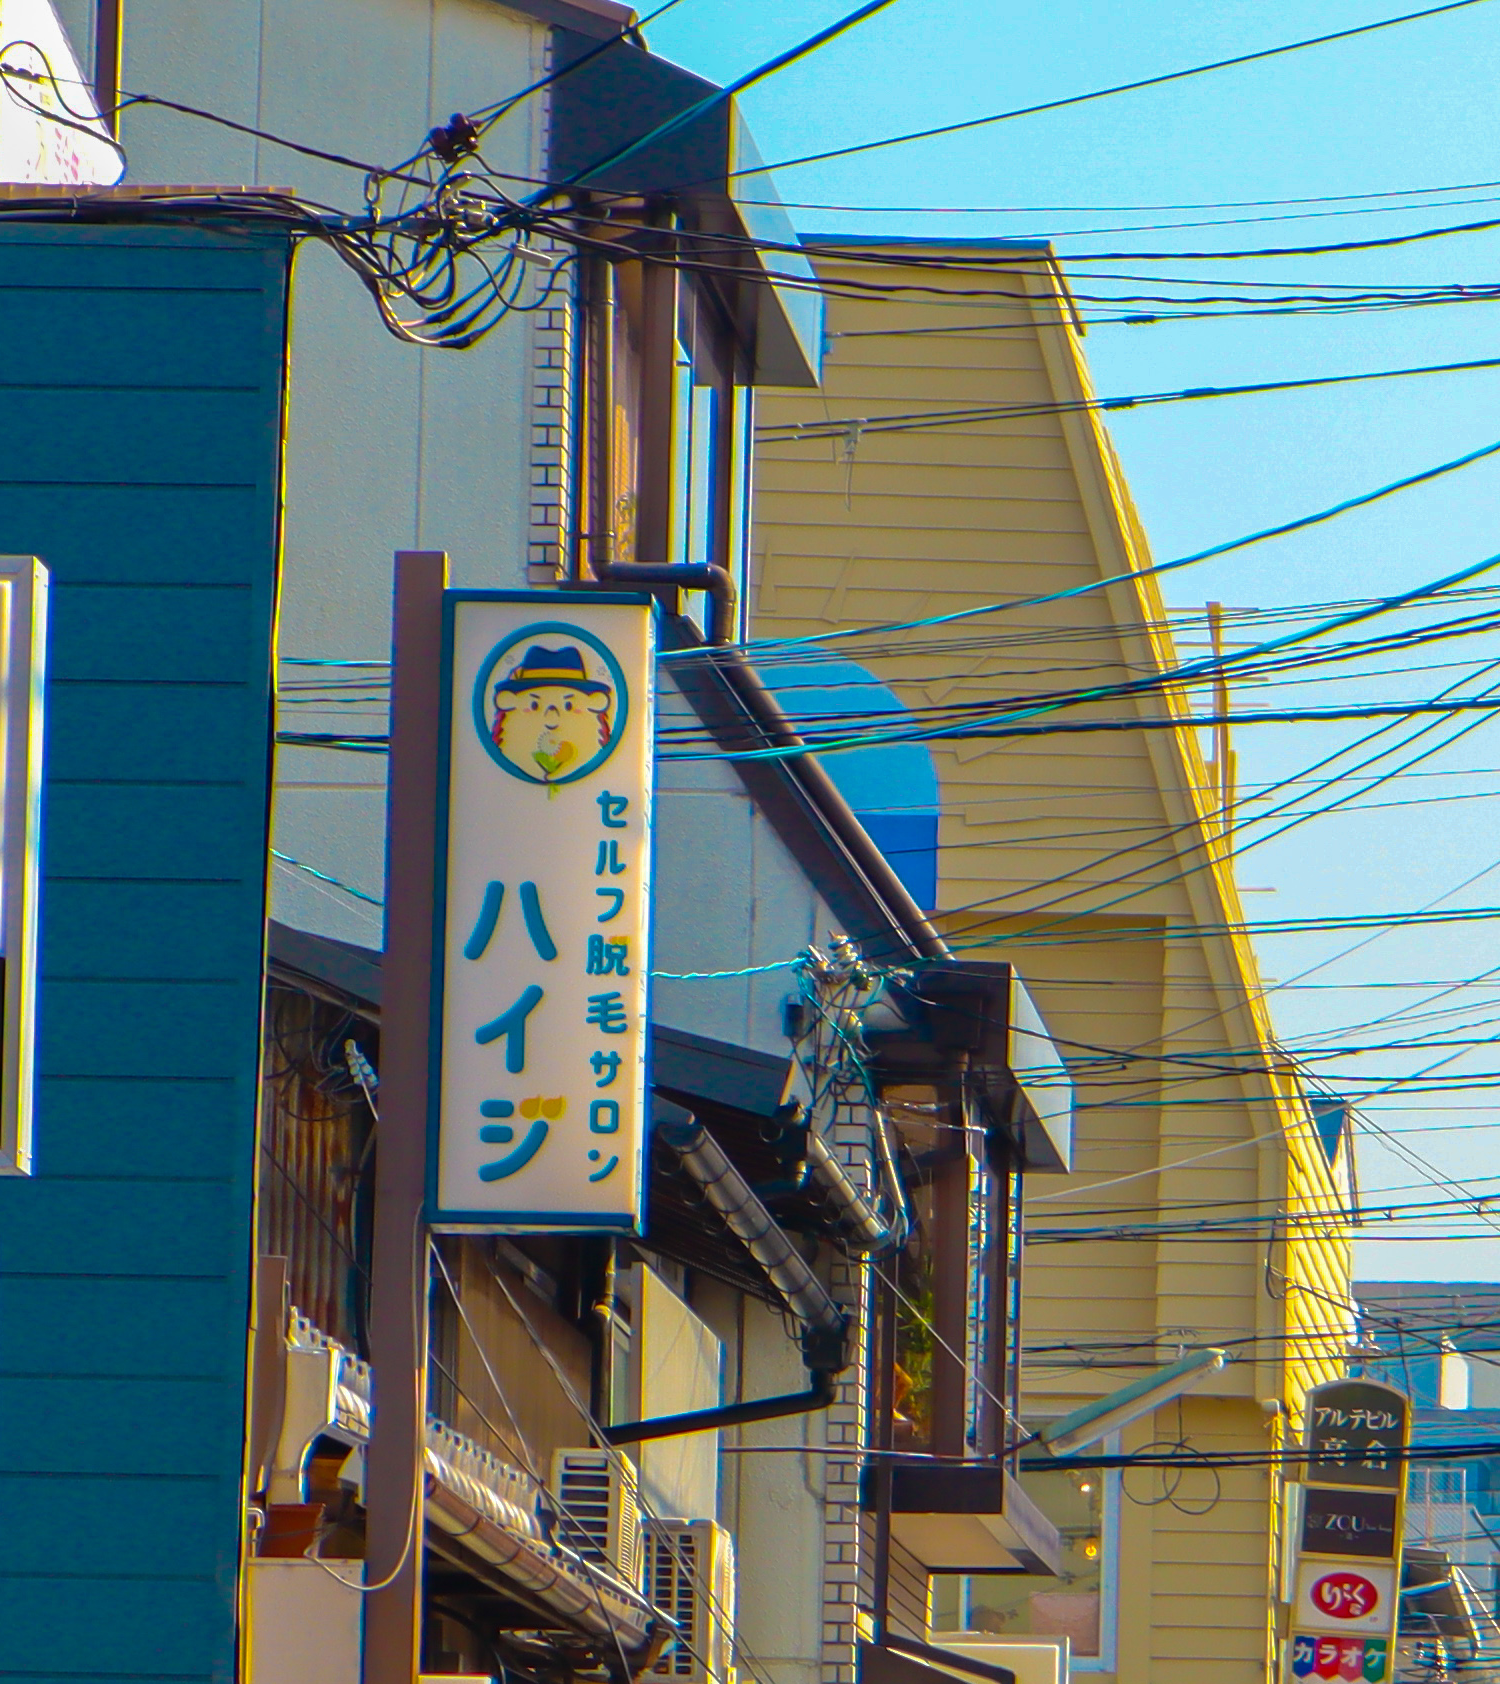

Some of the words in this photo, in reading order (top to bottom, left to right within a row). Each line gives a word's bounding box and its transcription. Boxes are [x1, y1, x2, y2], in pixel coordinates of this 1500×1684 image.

[463, 878, 566, 1184] ハイジ
[585, 789, 631, 1184] セルフ脱毛サロン
[1293, 1640, 1388, 1671] カラオケ
